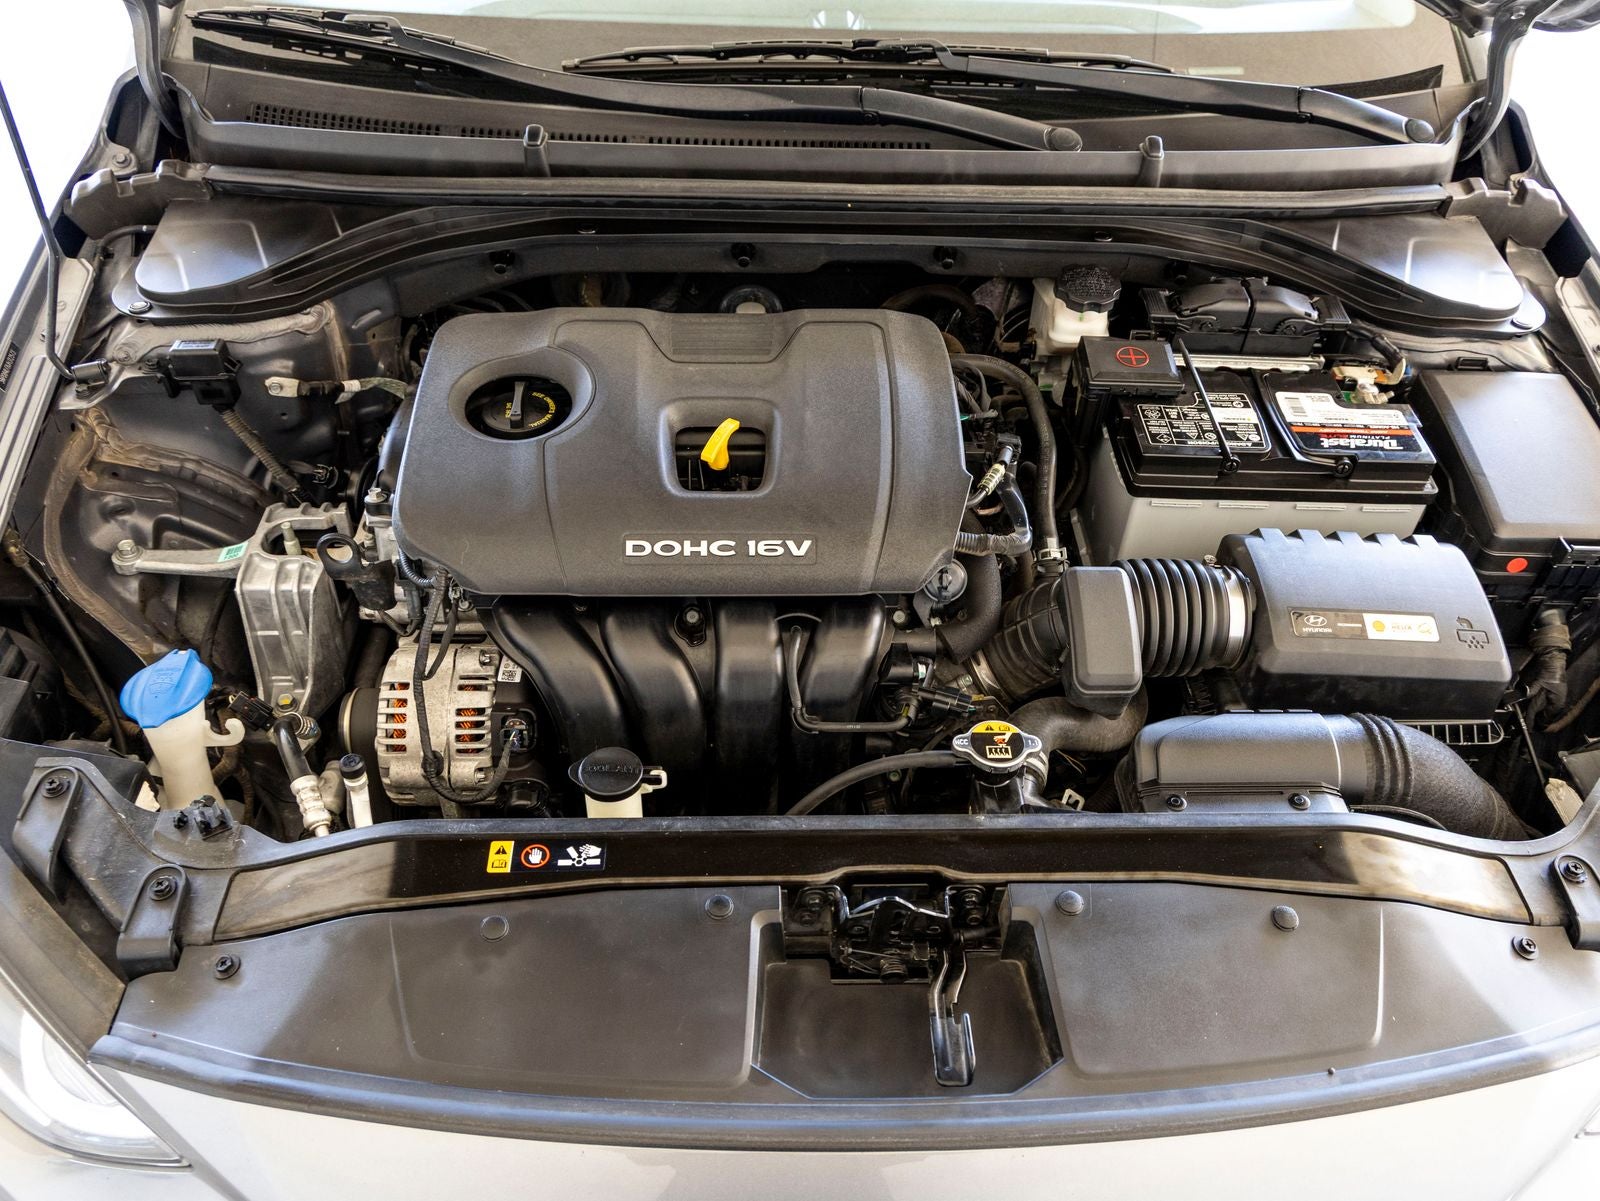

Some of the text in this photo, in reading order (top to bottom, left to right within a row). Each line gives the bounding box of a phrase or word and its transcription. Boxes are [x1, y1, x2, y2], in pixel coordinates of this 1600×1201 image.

[1319, 438, 1404, 450] Duralast
[625, 539, 813, 557] DOHC 16V
